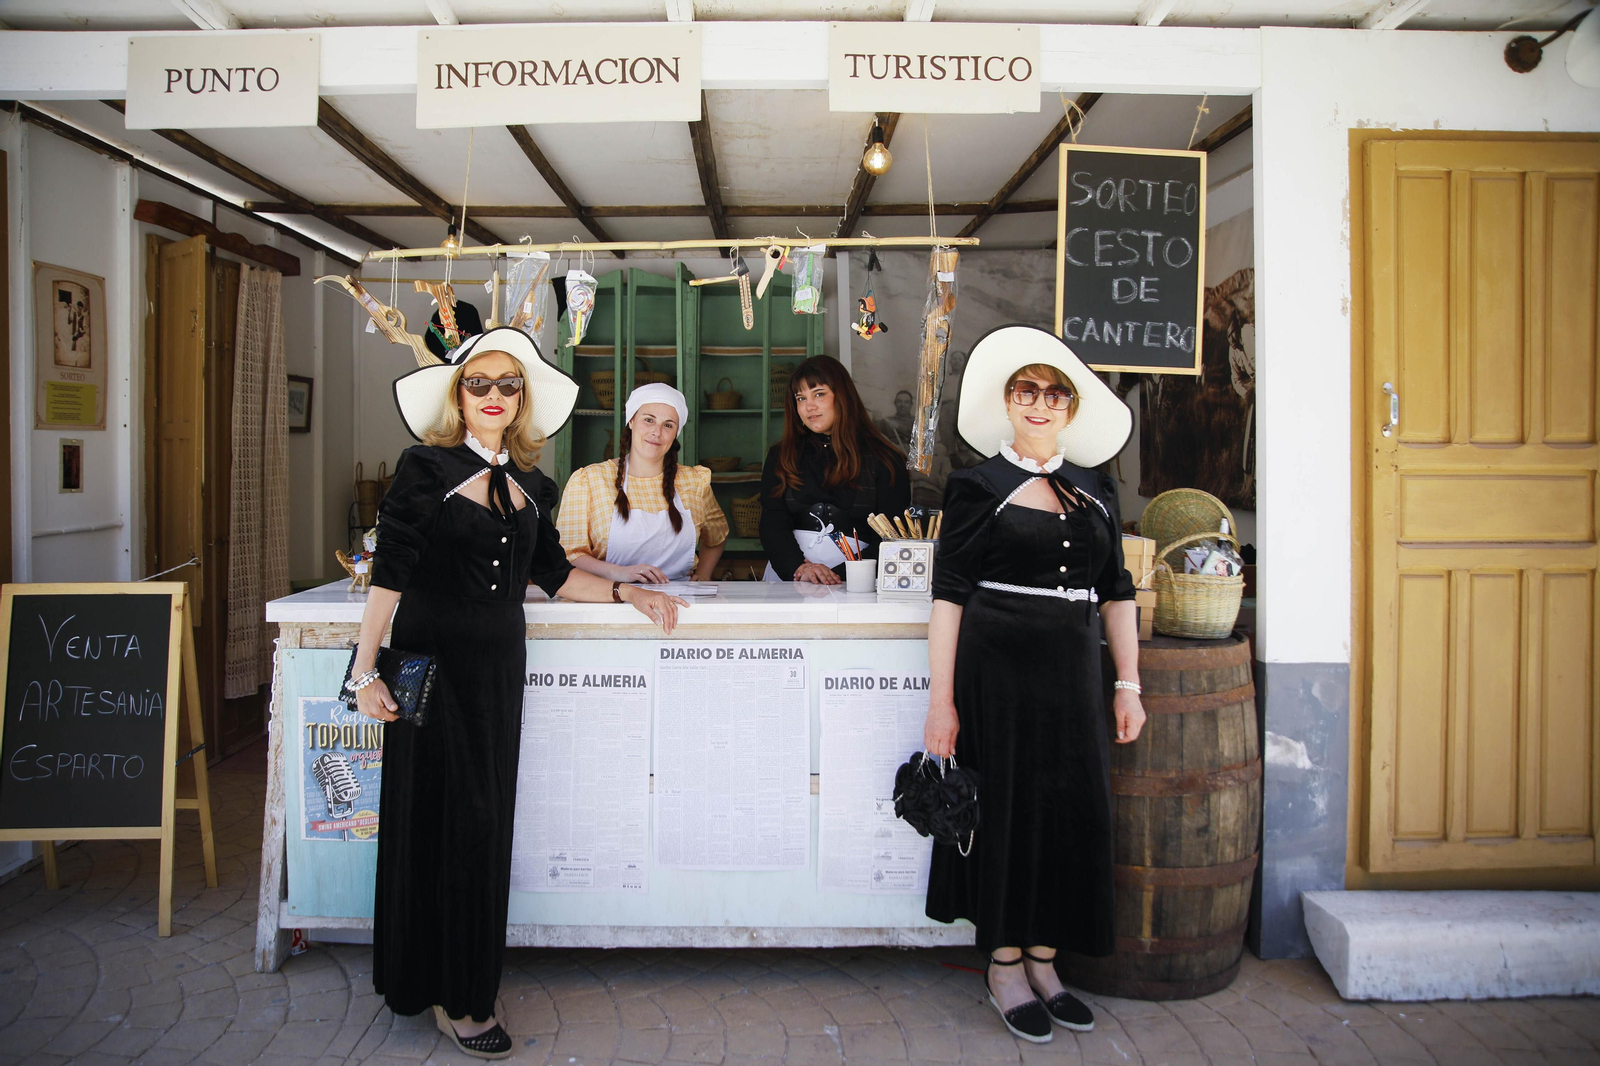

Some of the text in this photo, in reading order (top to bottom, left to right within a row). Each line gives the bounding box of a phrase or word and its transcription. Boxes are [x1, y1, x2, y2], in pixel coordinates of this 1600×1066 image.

[164, 67, 280, 95] PUNTO
[435, 57, 681, 90] INFORMACION
[844, 53, 1033, 83] TURISTICO
[1069, 171, 1198, 216] SORTEO
[1065, 227, 1193, 269] CESTO
[1111, 276, 1160, 304] DE
[1063, 316, 1196, 353] CANTERO
[60, 371, 86, 381] SORTEO
[660, 648, 805, 660] DIARIO DE ALMERIA
[524, 673, 647, 688] RIO DE ALMERIA
[789, 670, 797, 678] 30
[824, 676, 875, 690] DIARIO
[879, 677, 898, 690] DE
[330, 705, 369, 725] Radio
[306, 722, 385, 750] TOPOLIN
